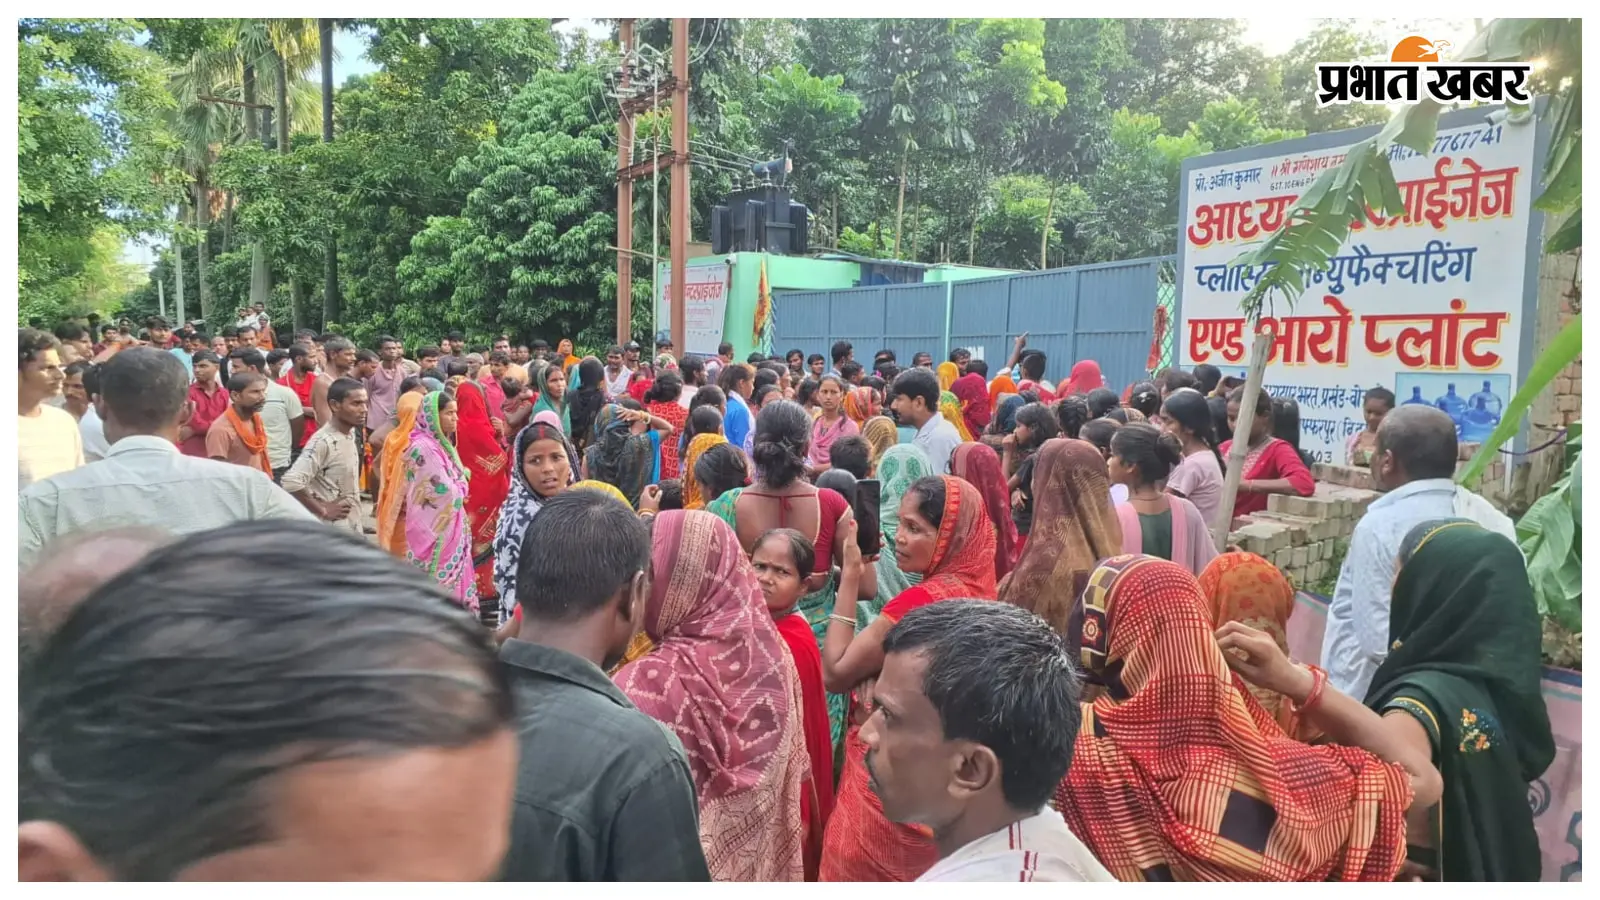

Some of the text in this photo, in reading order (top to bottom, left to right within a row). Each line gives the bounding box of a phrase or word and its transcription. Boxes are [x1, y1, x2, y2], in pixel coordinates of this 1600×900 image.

[1234, 167, 1263, 191] कुमार
[1188, 318, 1246, 364] एण्ड
[1360, 298, 1508, 368] प्लांट
